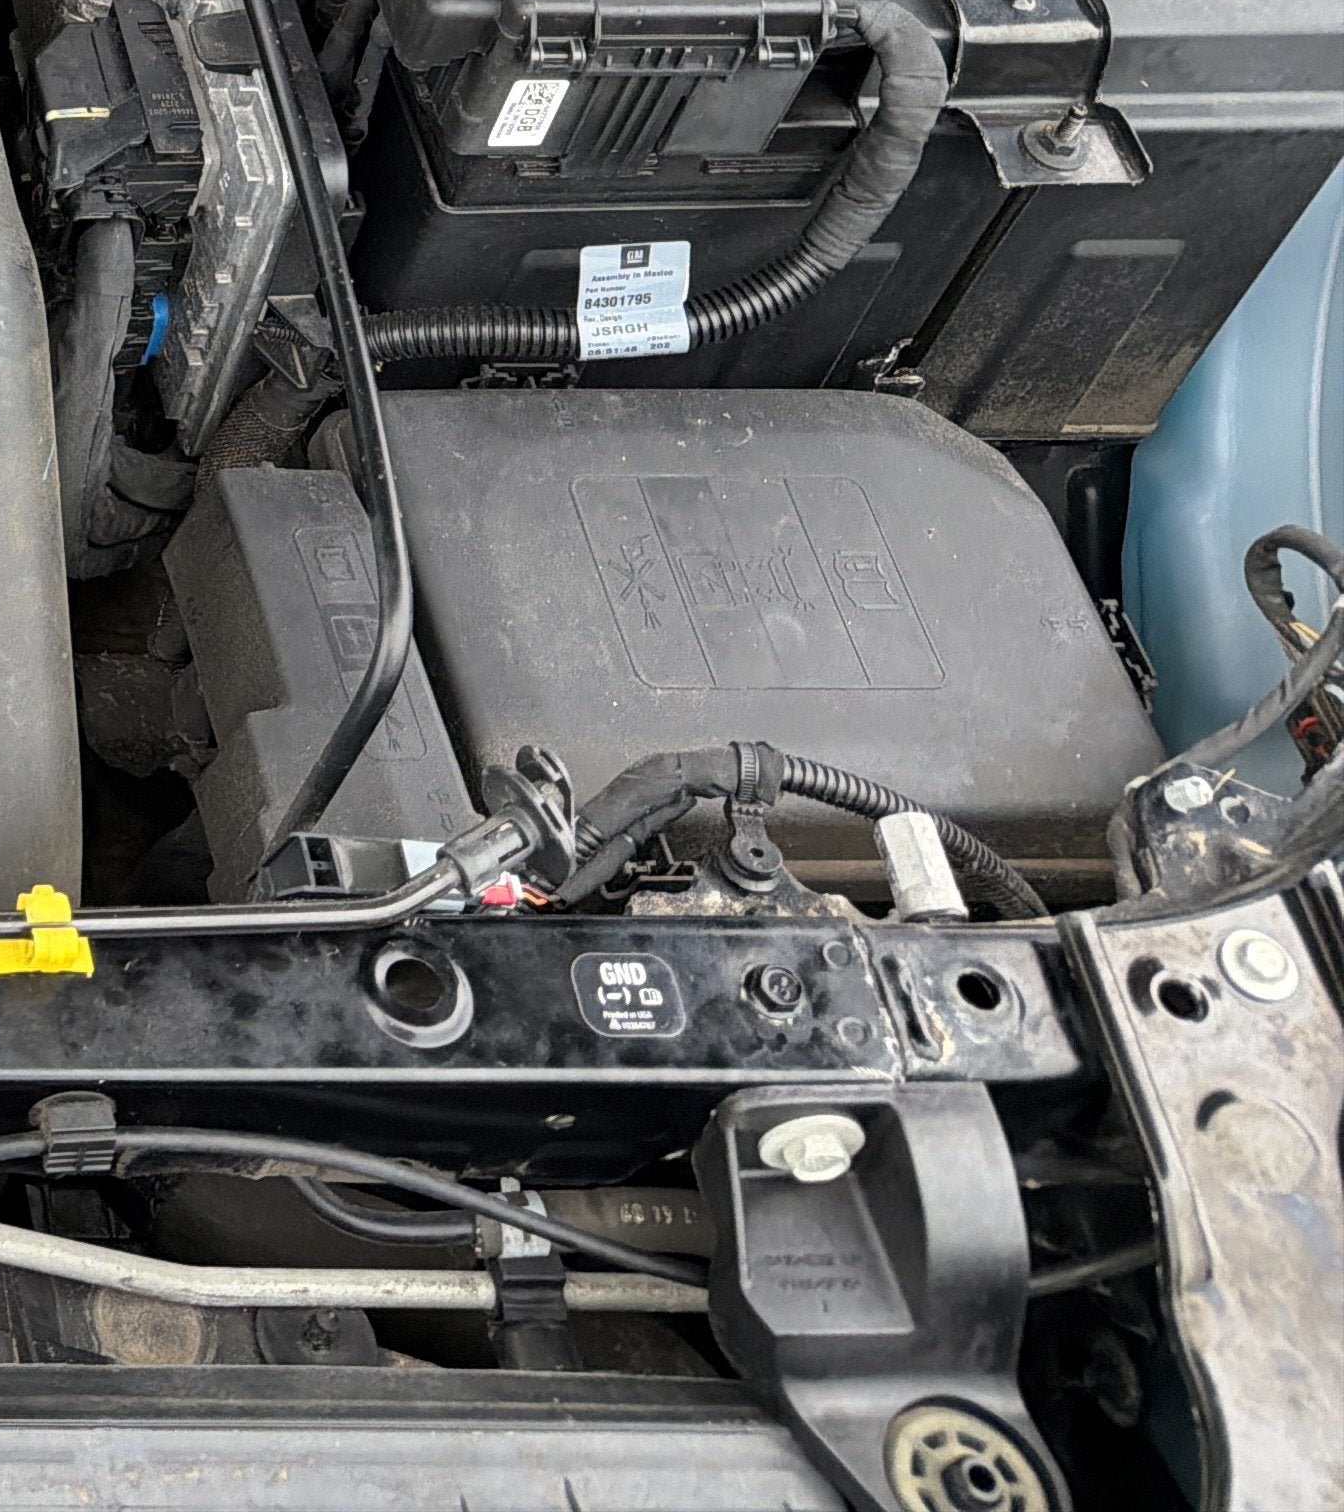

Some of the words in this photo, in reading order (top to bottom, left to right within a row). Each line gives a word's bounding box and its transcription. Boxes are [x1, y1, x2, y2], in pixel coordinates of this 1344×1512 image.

[591, 273, 631, 282] Assembly
[643, 269, 674, 278] Mexico
[600, 285, 627, 293] Number
[599, 962, 647, 985] GND
[636, 1010, 653, 1019] USA
